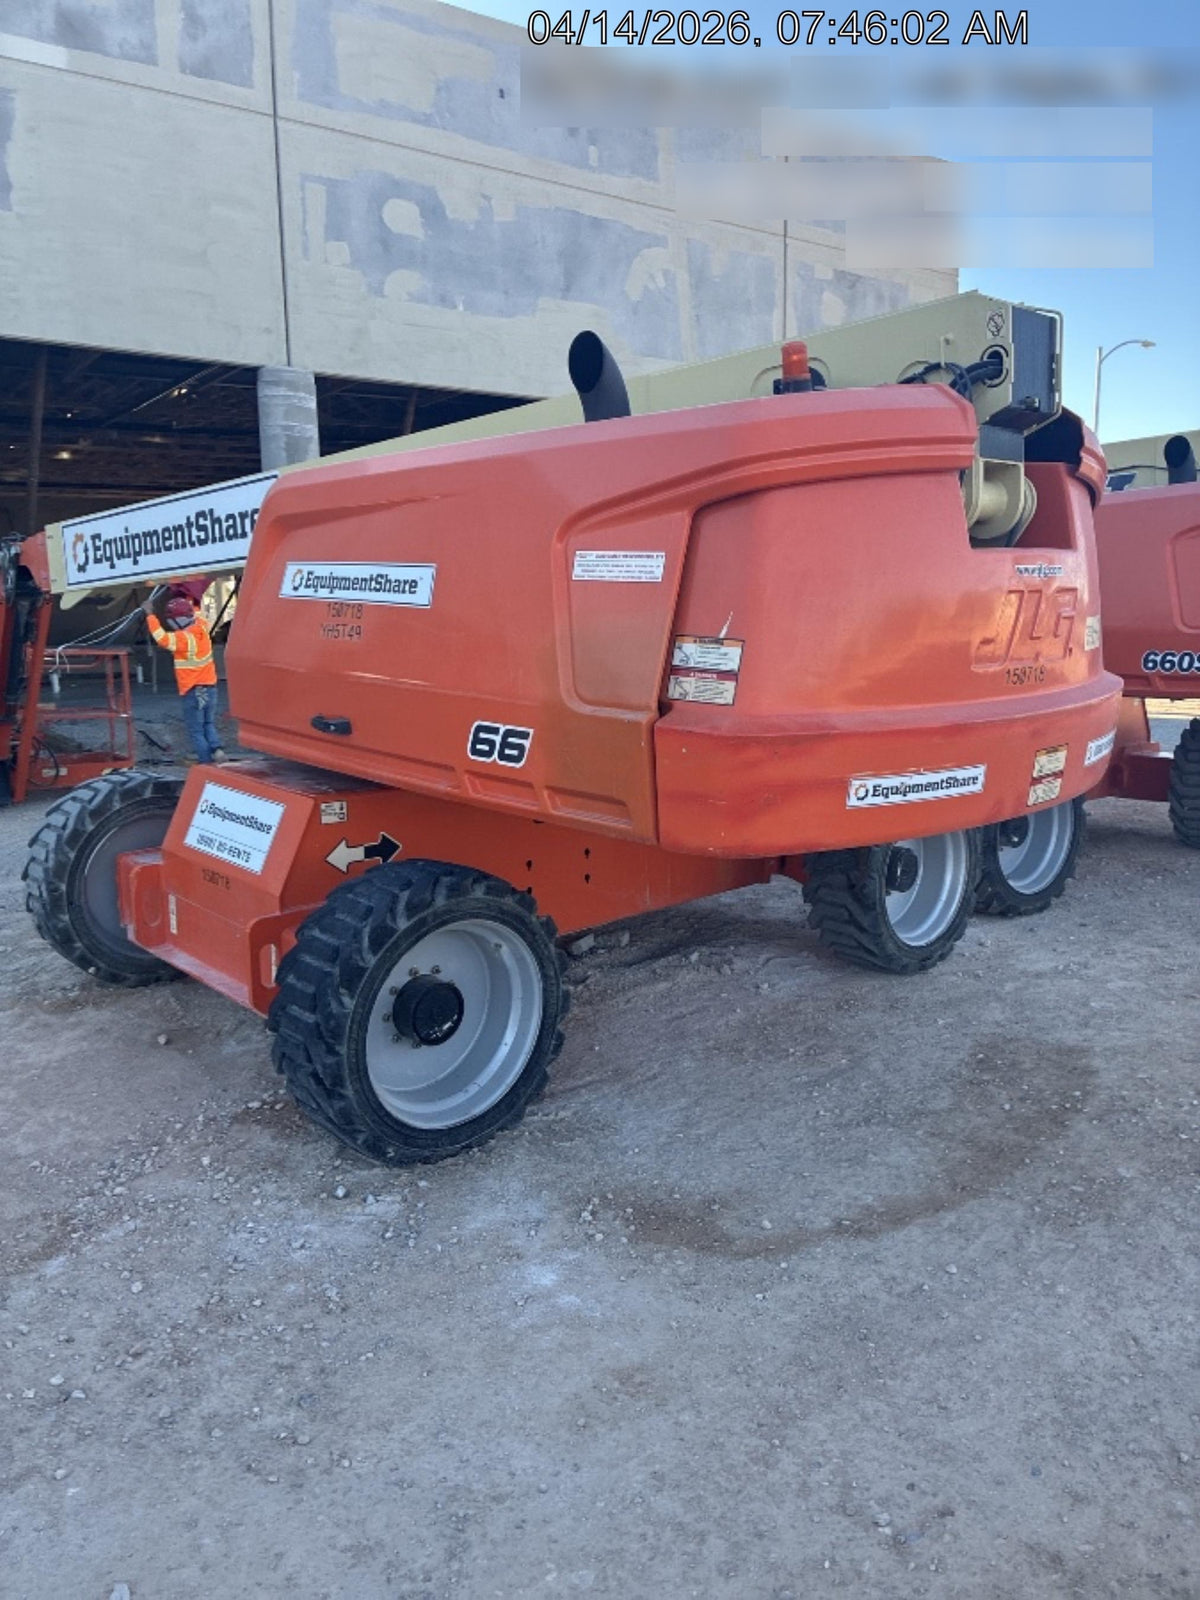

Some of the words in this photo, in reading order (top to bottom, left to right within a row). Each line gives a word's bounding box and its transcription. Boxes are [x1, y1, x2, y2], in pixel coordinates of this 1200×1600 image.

[303, 570, 418, 595] EquipmentShare
[1142, 650, 1200, 674] 660
[467, 720, 534, 768] 66
[871, 775, 979, 799] EquipmentShare
[208, 802, 273, 835] EquipmentShare
